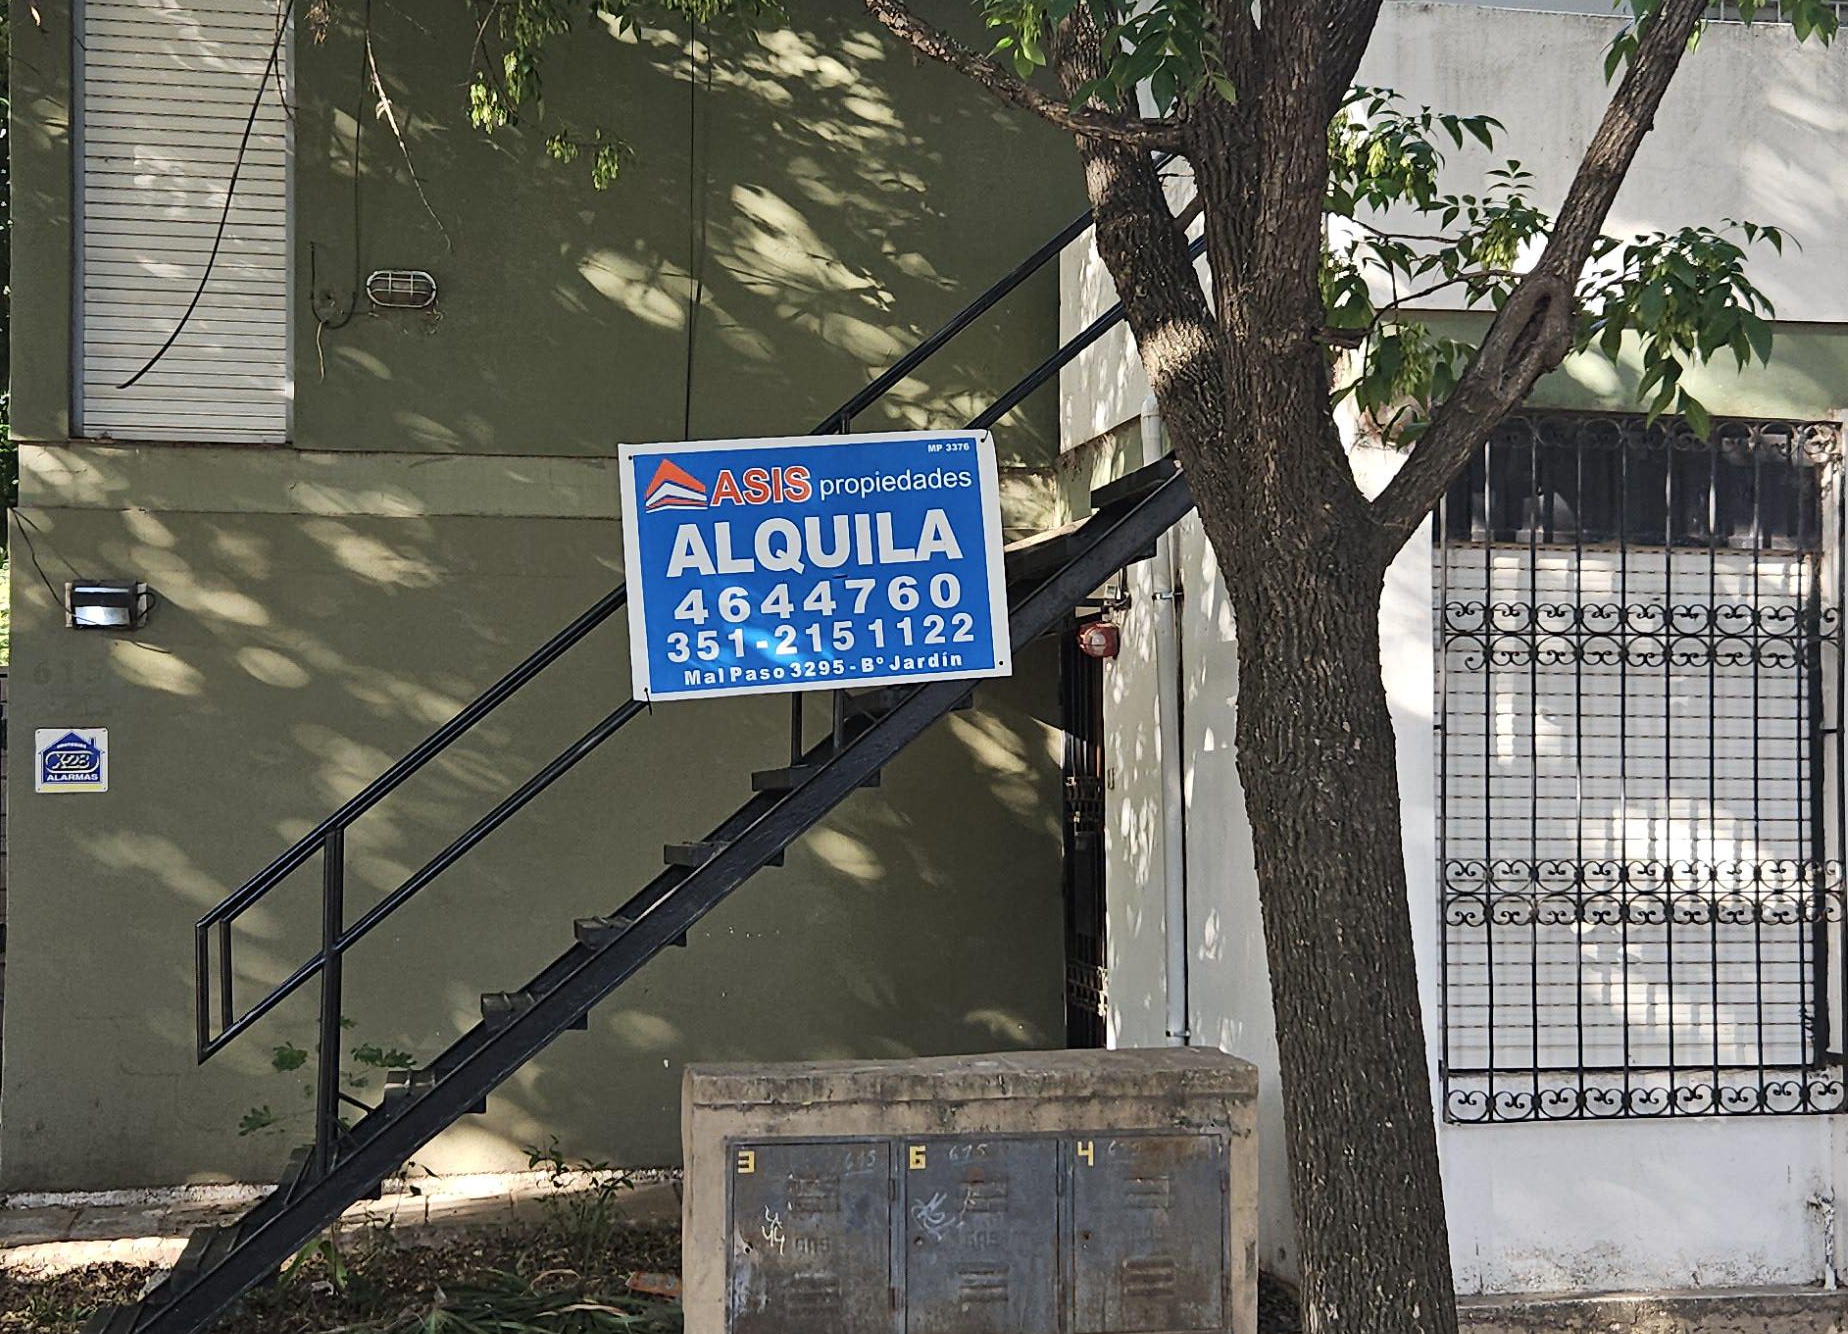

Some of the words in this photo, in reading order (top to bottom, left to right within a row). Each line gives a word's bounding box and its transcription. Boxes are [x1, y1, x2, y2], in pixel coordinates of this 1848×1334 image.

[927, 444, 943, 453] MP
[709, 466, 812, 506] ASIS
[819, 467, 972, 501] propiedades
[666, 508, 963, 578] ALQUILA
[674, 572, 962, 624] 4644760
[666, 612, 975, 663] 351-2151122
[684, 669, 725, 686] Mal
[731, 667, 785, 683] Paso
[790, 659, 845, 678] 3295
[889, 651, 963, 671] Jardín
[46, 773, 99, 782] ALARMAS
[737, 1150, 755, 1174] 3
[909, 1145, 926, 1170] 6
[1077, 1141, 1094, 1167] 4
